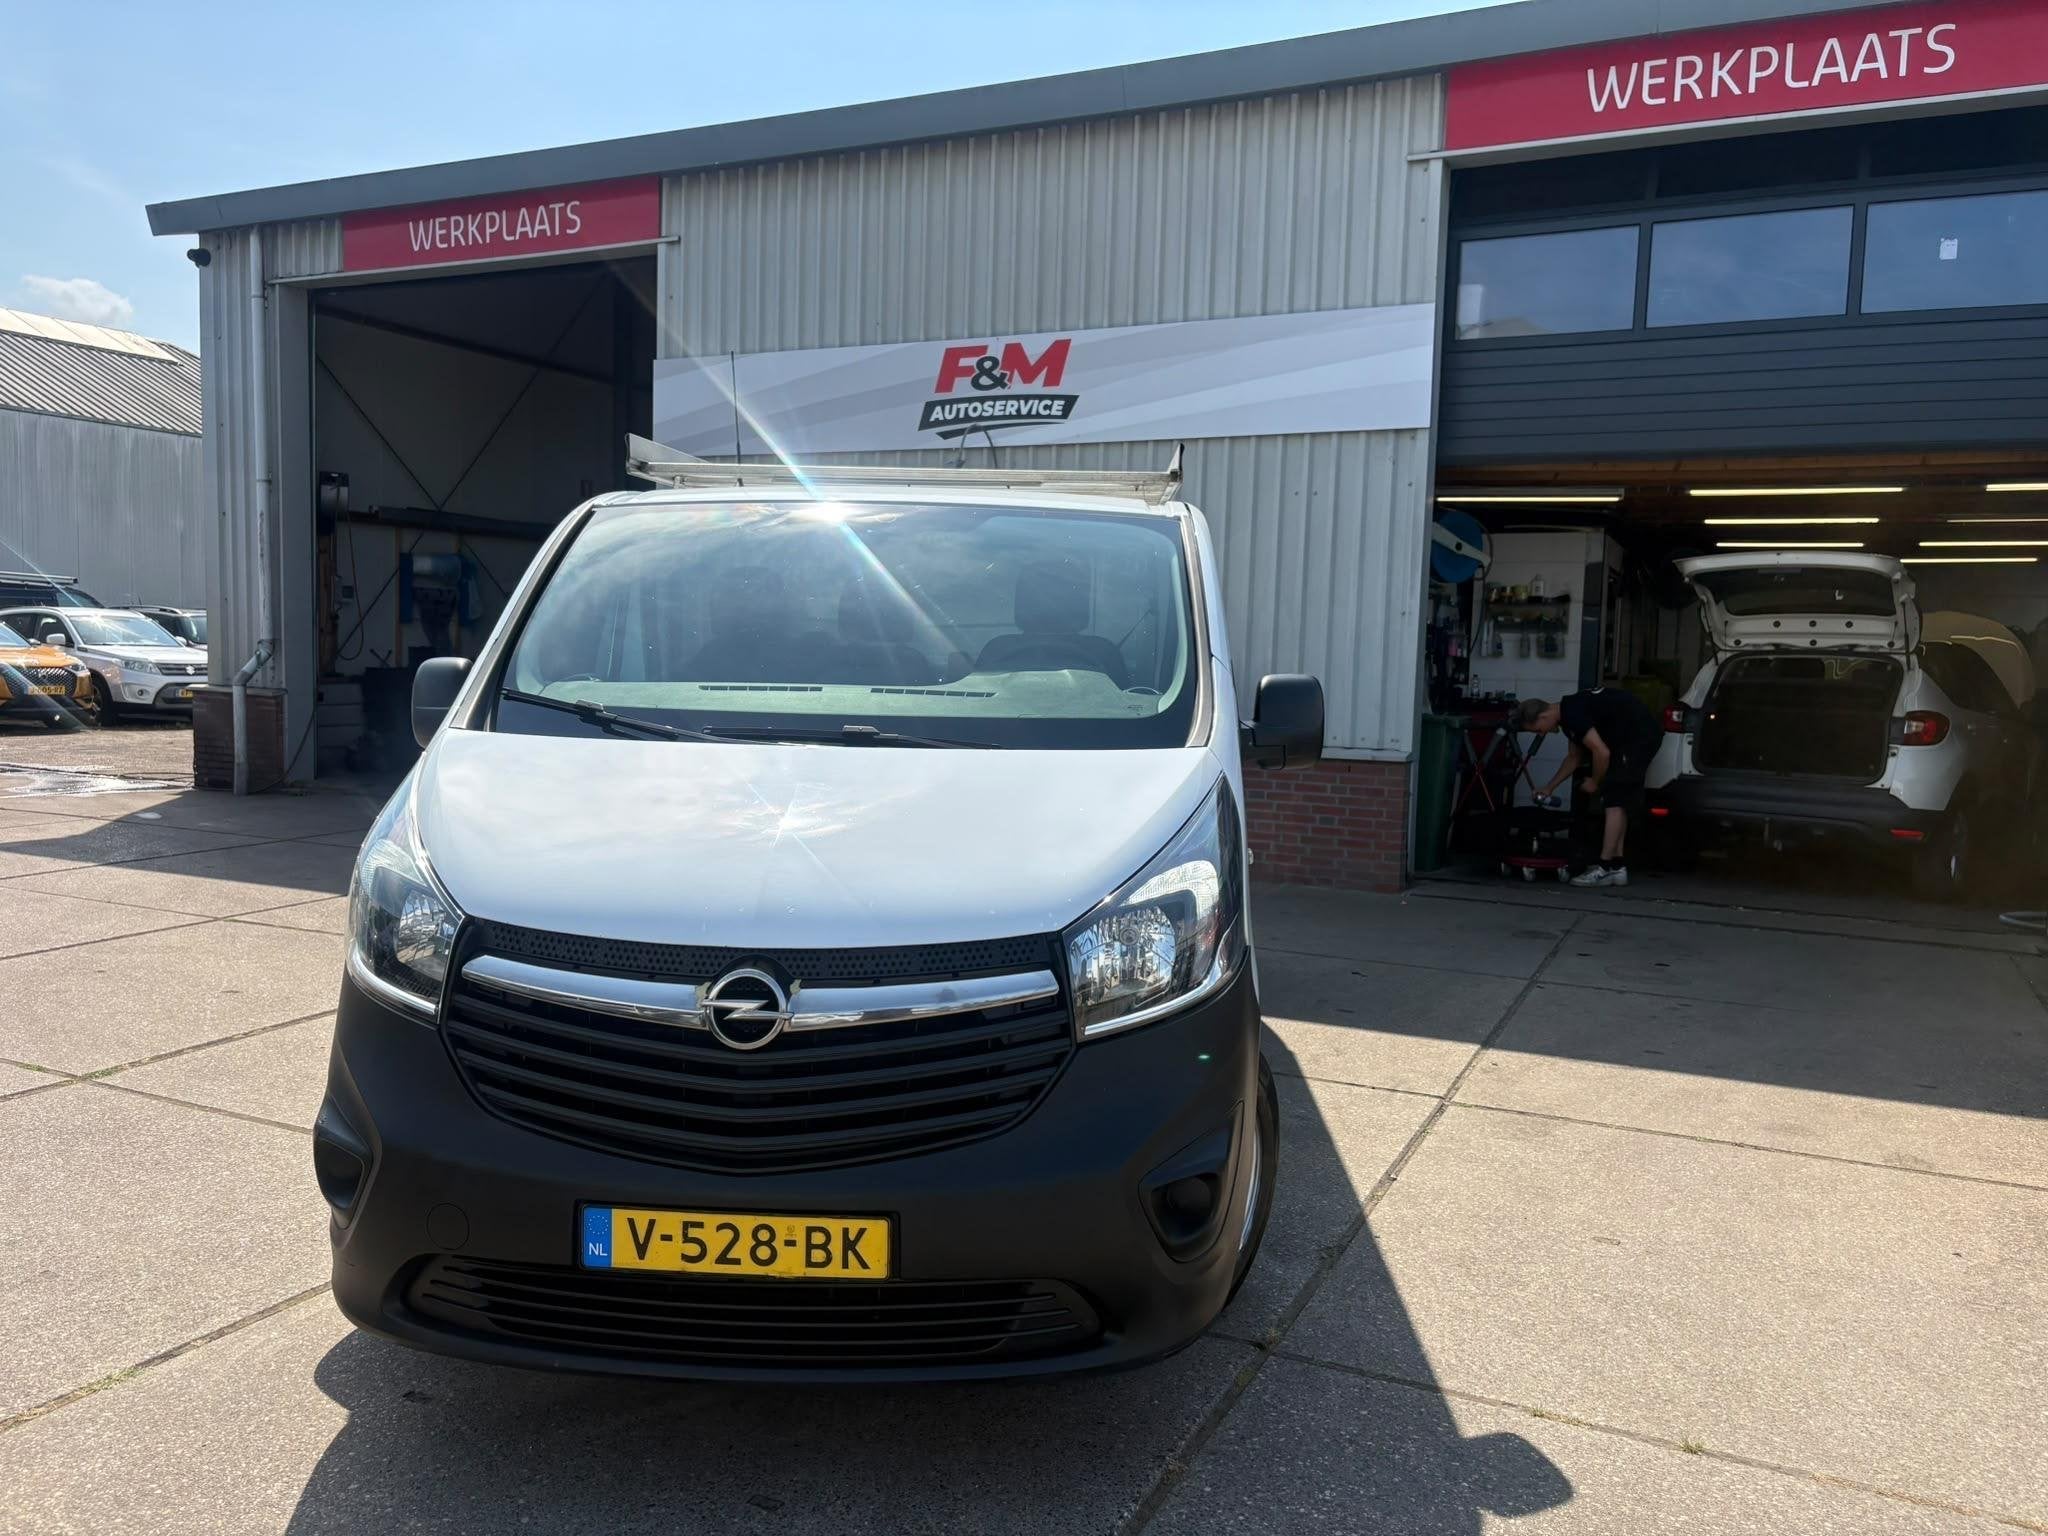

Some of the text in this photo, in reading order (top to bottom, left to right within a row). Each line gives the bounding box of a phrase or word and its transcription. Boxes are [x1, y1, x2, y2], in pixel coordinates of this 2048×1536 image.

[1586, 23, 1957, 113] WERKPLAATS
[409, 201, 581, 251] WERKPLAATS
[934, 338, 1072, 393] F&M
[929, 399, 1066, 422] AUTOSERVICE
[588, 1217, 871, 1270] NL V-528-BK
